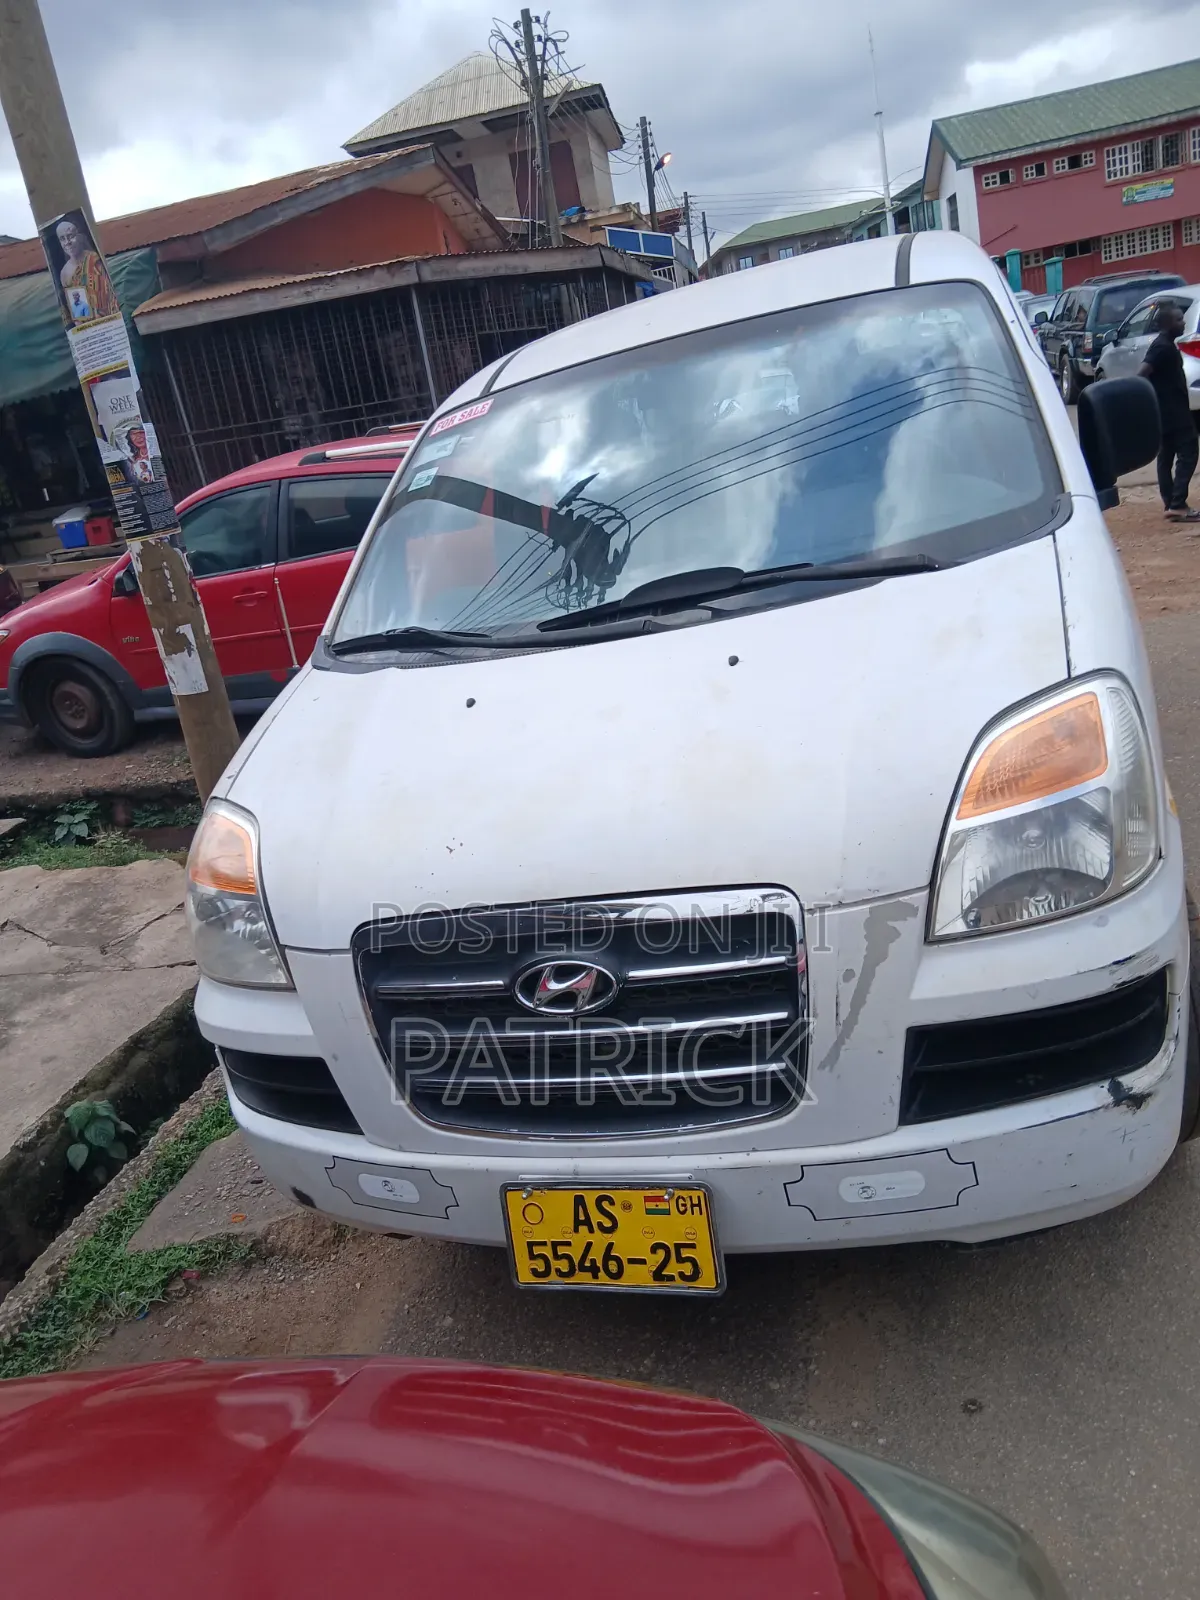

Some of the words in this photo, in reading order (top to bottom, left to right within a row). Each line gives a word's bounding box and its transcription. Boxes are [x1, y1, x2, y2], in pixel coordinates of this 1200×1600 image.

[109, 401, 136, 412] WEEK
[434, 416, 457, 433] FOR
[458, 403, 489, 422] SALE
[573, 1194, 619, 1235] AS
[675, 1195, 703, 1216] GH
[526, 1240, 702, 1283] 5546-25
